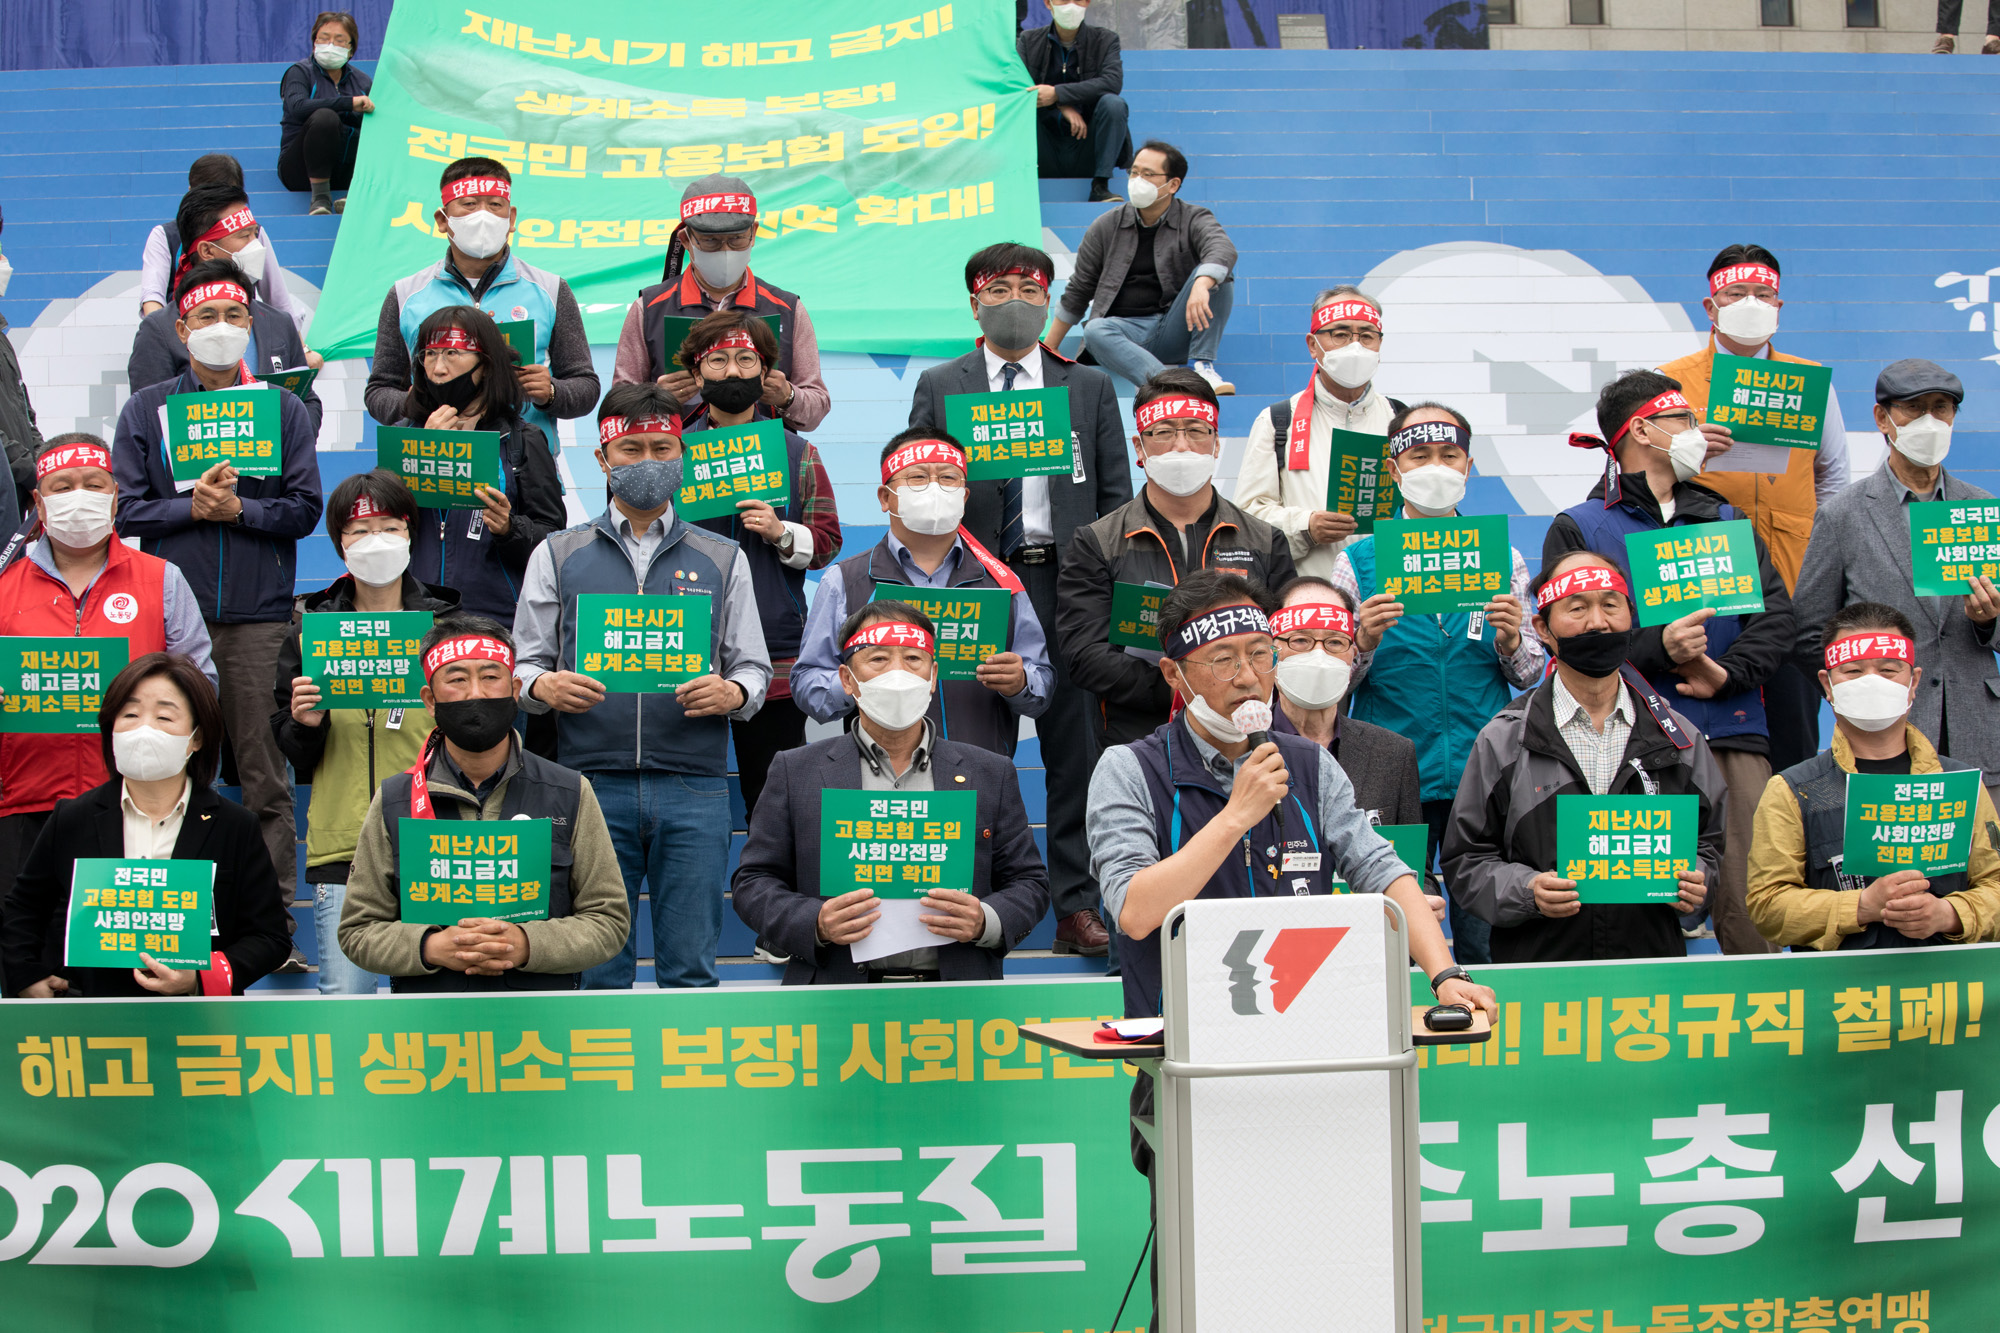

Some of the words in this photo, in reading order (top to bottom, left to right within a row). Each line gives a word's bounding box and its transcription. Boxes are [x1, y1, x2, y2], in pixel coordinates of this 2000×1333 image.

[461, 9, 685, 68] 재난시기
[701, 38, 814, 67] 해고
[829, 3, 954, 59] 금지!
[515, 89, 746, 120] 생계소득
[764, 81, 897, 114] 보장!
[406, 125, 587, 179] 전국민
[602, 132, 845, 179] 고용보험
[862, 104, 995, 154] 도입!
[453, 178, 479, 198] 단결
[683, 198, 704, 217] 단결
[722, 196, 750, 212] 투쟁
[855, 181, 994, 226] 확대!
[221, 208, 249, 232] 단결
[1714, 268, 1736, 289] 단결
[1755, 266, 1778, 288] 투쟁
[182, 287, 205, 310] 단결
[1318, 303, 1345, 325] 단결
[1735, 368, 1805, 393] 재난시기
[1732, 388, 1802, 411] 해고금지
[186, 401, 254, 421] 재난시기
[971, 401, 1043, 422] 재난시기
[1140, 401, 1165, 427] 단결
[1186, 399, 1214, 422] 투쟁
[1713, 405, 1817, 432] 생계소득보장
[188, 421, 254, 440] 해고금지
[972, 421, 1044, 442] 해고금지
[76, 447, 107, 468] 투쟁
[176, 440, 273, 462] 생계소득보장
[402, 439, 472, 460] 재난시기
[690, 434, 761, 461] 재난시기
[402, 458, 472, 479] 해고금지
[693, 454, 764, 481] 해고금지
[888, 447, 915, 474] 단결
[936, 444, 963, 467] 투쟁
[679, 471, 783, 504] 생계소득보장
[1356, 458, 1378, 517] 해고금지
[1950, 506, 2000, 524] 전국민
[1402, 529, 1479, 550] 재난시기
[1923, 526, 1989, 544] 고용보험
[1654, 535, 1730, 561] 재난시기
[1403, 550, 1481, 573] 해고금지
[1659, 555, 1733, 582] 해고금지
[1942, 564, 1974, 581] 전면
[1981, 563, 2000, 579] 확
[1384, 571, 1501, 596] 생계소득보장
[1574, 569, 1612, 589] 투쟁
[1643, 575, 1753, 607] 생계소득보장
[109, 611, 132, 620] 노동당
[604, 608, 684, 628] 재난시기
[1269, 610, 1293, 635] 단결
[1317, 607, 1349, 631] 투쟁
[339, 620, 390, 637] 전국민
[891, 625, 926, 648] 투쟁
[312, 640, 379, 657] 고용보험
[387, 639, 420, 656] 도입
[604, 630, 684, 650] 해고금지
[21, 651, 99, 669] 재난시기
[427, 640, 455, 671] 단결
[480, 638, 510, 665] 투쟁
[1827, 640, 1851, 666] 단결
[1874, 636, 1907, 658] 투쟁
[323, 659, 410, 676] 사회안전망
[583, 653, 703, 673] 생계소득보장
[21, 673, 100, 691] 해고금지
[330, 678, 364, 695] 전면
[371, 678, 405, 695] 확대
[3, 695, 103, 713] 생계소득보
[1894, 782, 1945, 801] 전국민
[869, 799, 928, 818] 전국민
[1860, 803, 1933, 822] 고용보험
[1938, 800, 1967, 820] 도입
[835, 820, 914, 840] 고용보험
[923, 822, 961, 840] 도입
[1588, 810, 1671, 831] 재난시기
[1872, 822, 1955, 843] 사회안전망
[430, 834, 518, 856] 재난시기
[848, 842, 948, 862] 사회안전망
[1588, 835, 1671, 855] 해고금지
[1877, 846, 1913, 864] 전면
[1921, 843, 1948, 862] 확대
[114, 867, 168, 886] 전국민
[430, 859, 518, 880] 해고금지
[854, 864, 893, 883] 전면
[902, 865, 941, 883] 확대
[1566, 859, 1689, 880] 생계소득보장
[82, 888, 154, 909] 고용보험
[161, 890, 198, 910] 도입
[409, 881, 541, 905] 생계소득보장
[94, 911, 185, 931] 사회안전망
[100, 932, 136, 951] 전면
[144, 933, 179, 953] 확대
[17, 1035, 154, 1097] 해고
[176, 1034, 334, 1097] 금지!
[359, 1029, 634, 1094] 생계소득
[661, 1024, 818, 1088] 보장!
[1543, 990, 1804, 1062] 비정규직
[1833, 981, 1984, 1054] 철폐!
[234, 1142, 1086, 1303] 세계노동절
[1830, 1090, 2000, 1243] 선
